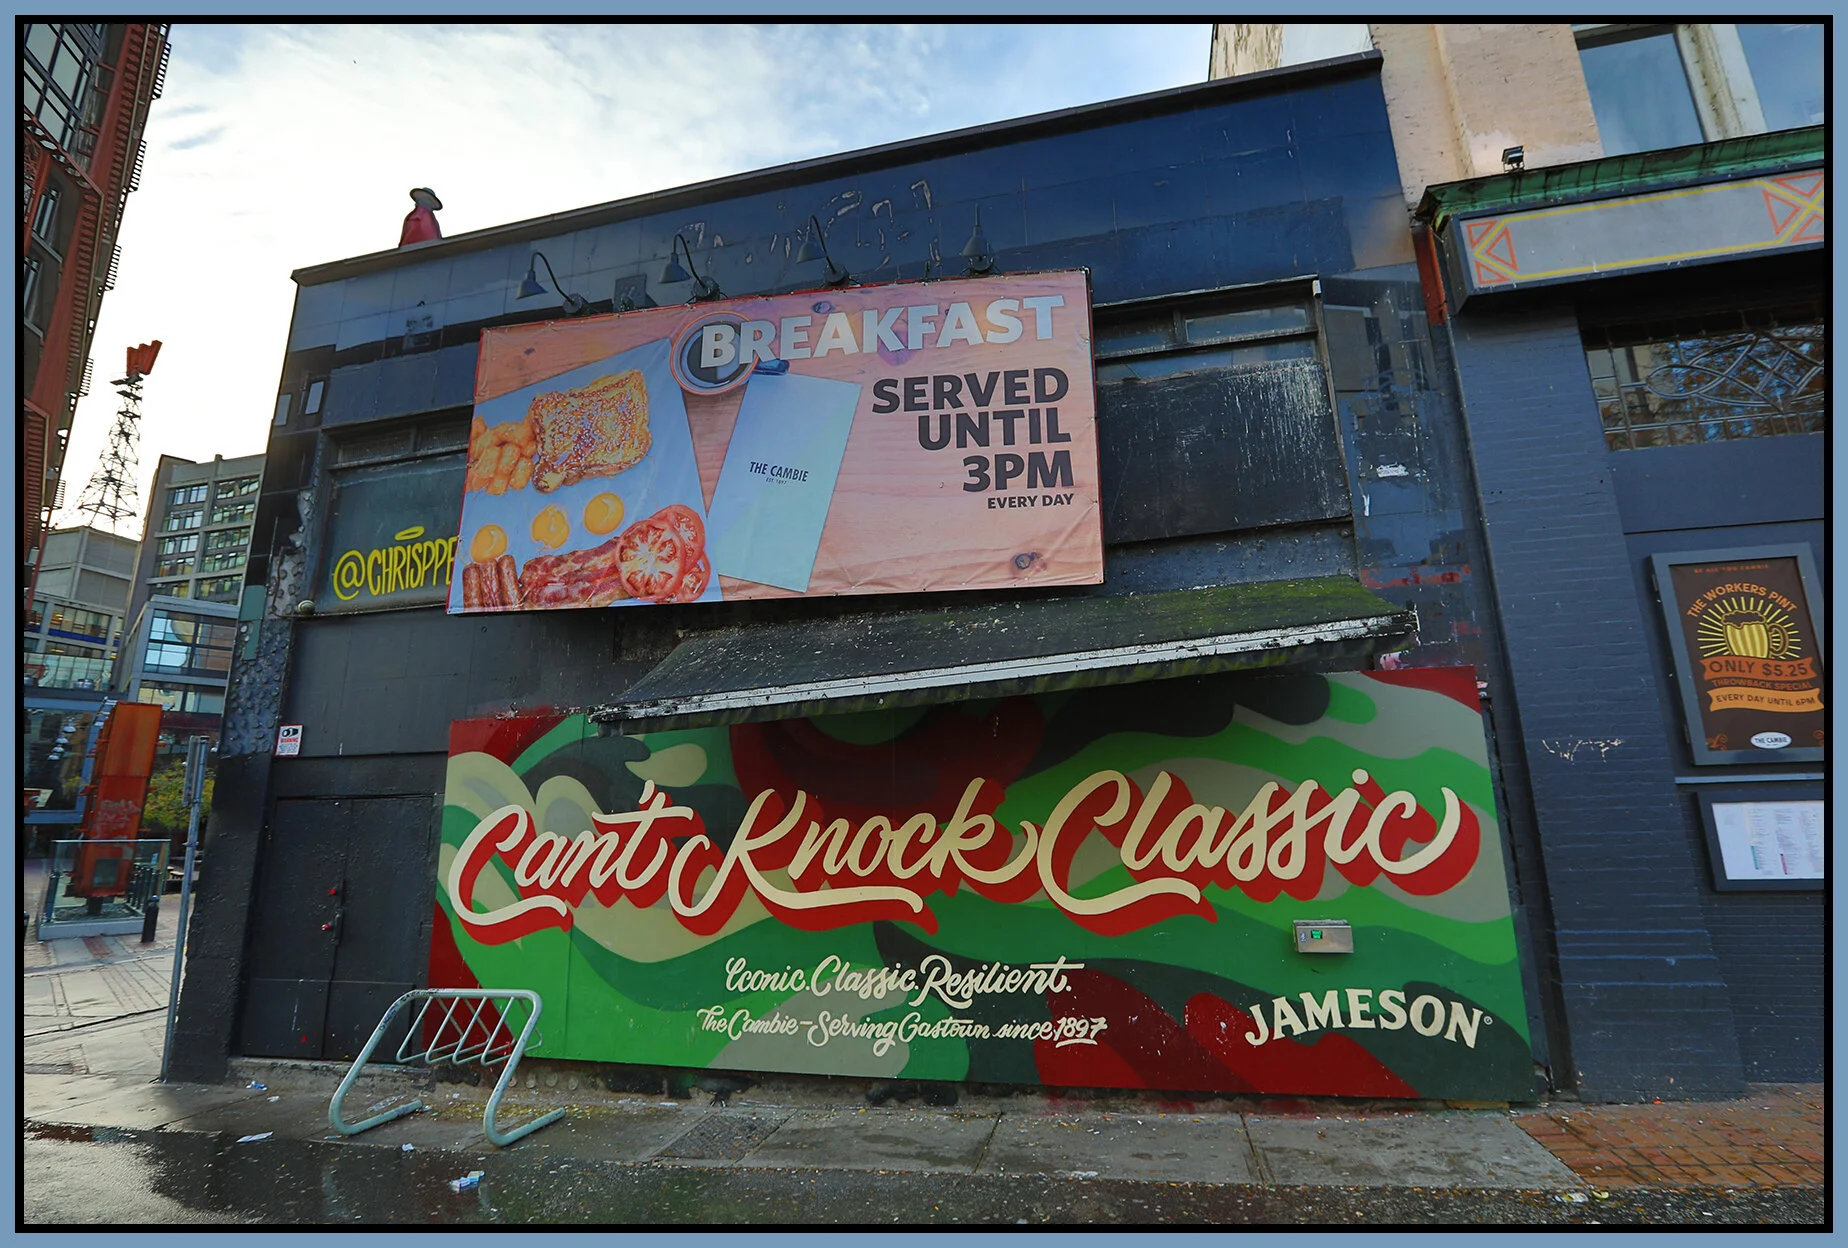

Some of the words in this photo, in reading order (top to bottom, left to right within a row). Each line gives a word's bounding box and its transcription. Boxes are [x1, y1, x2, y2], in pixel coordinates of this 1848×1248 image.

[699, 295, 1065, 368] BREAKFAST
[871, 366, 1069, 414] SERVED
[917, 406, 1071, 451] UNTIL
[749, 461, 768, 475] THE
[770, 465, 809, 482] CAMBIE
[962, 450, 1075, 493] 3PM
[987, 495, 1038, 510] EVERY
[1041, 493, 1075, 508] DAY
[1687, 598, 1708, 618] THE
[1703, 582, 1768, 601] WORKERS
[1768, 591, 1798, 612] PINT
[1709, 659, 1755, 674] ONLY
[1762, 663, 1808, 677] $5.25
[1712, 678, 1773, 689] THROWBACK
[1773, 680, 1813, 691] SPECIAL
[1716, 693, 1744, 703] EVERY
[1747, 694, 1765, 703] DAY
[1767, 697, 1793, 707] UNTIL
[1795, 696, 1816, 706] 6PM
[668, 777, 1039, 917] Knock
[1037, 768, 1461, 915] Classic
[697, 1004, 727, 1033] The
[898, 1011, 991, 1044] Gastown
[1053, 1016, 1108, 1047] 1897
